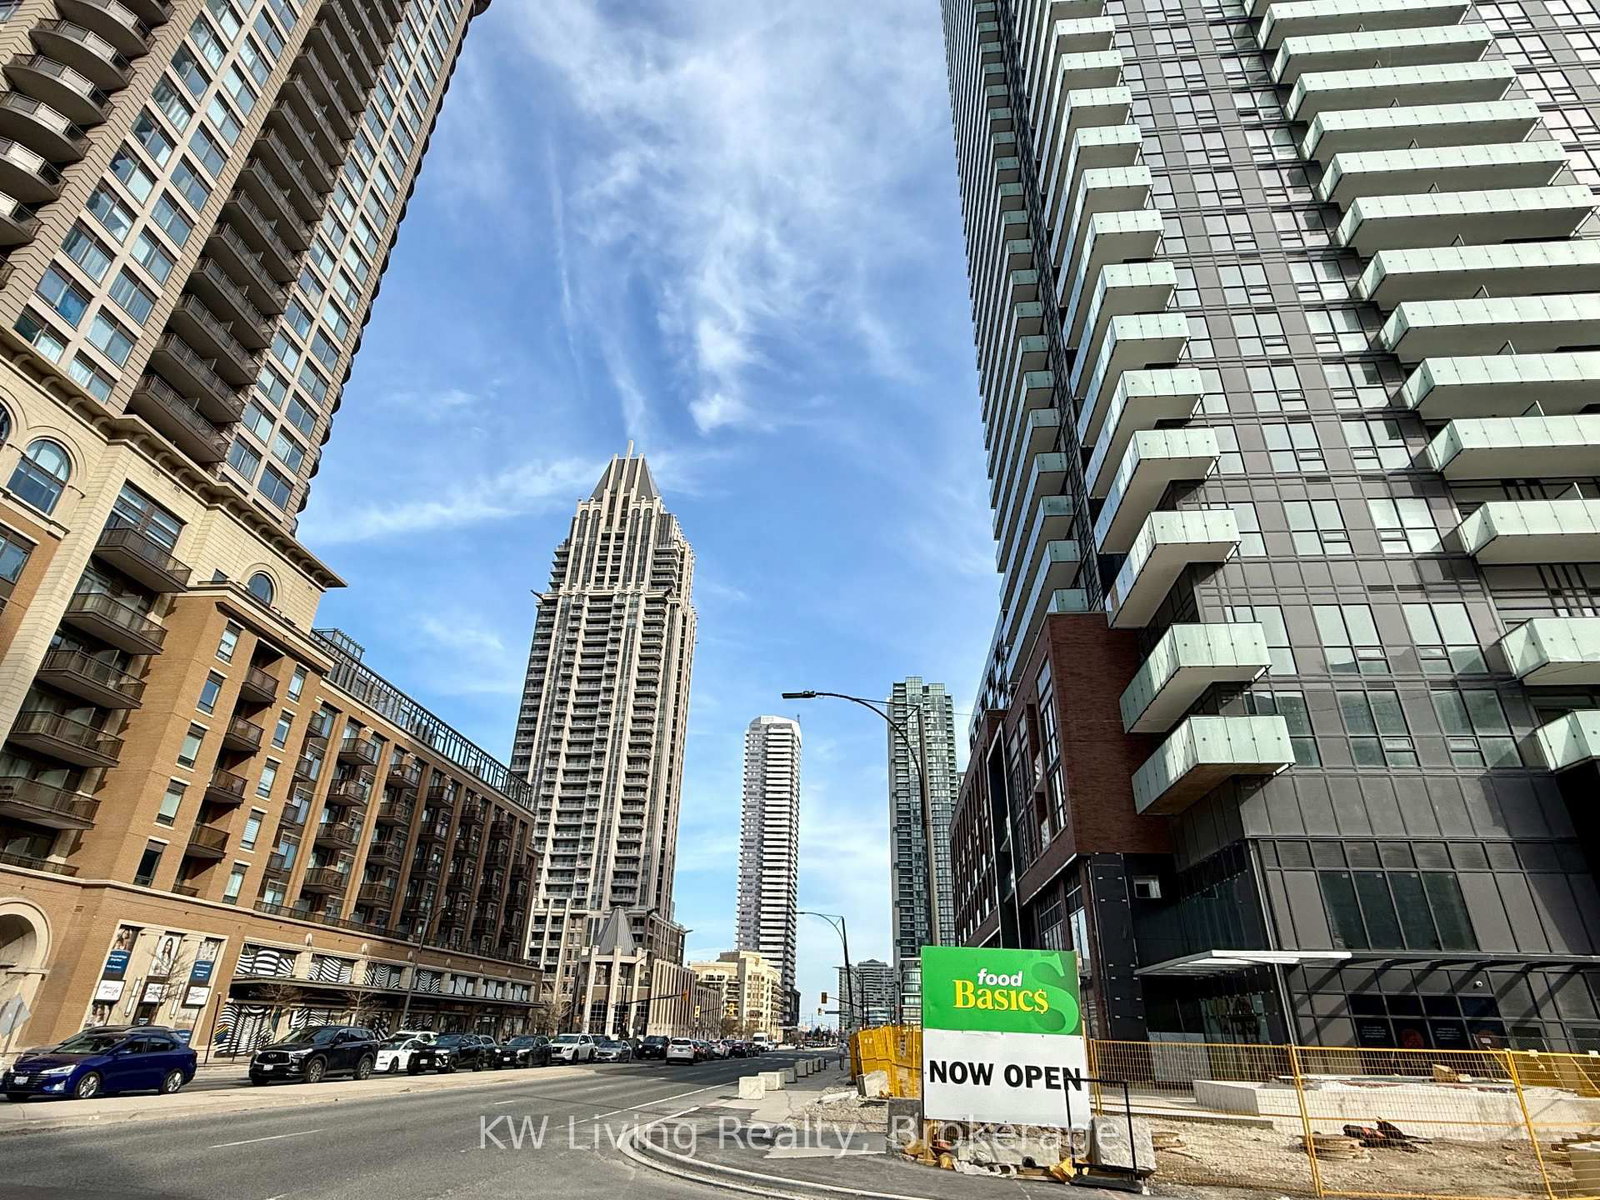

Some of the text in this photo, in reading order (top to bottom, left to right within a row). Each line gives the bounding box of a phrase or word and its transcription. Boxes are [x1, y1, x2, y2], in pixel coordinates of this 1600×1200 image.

[977, 968, 1024, 987] food
[929, 1060, 1082, 1091] NOW OPEN
